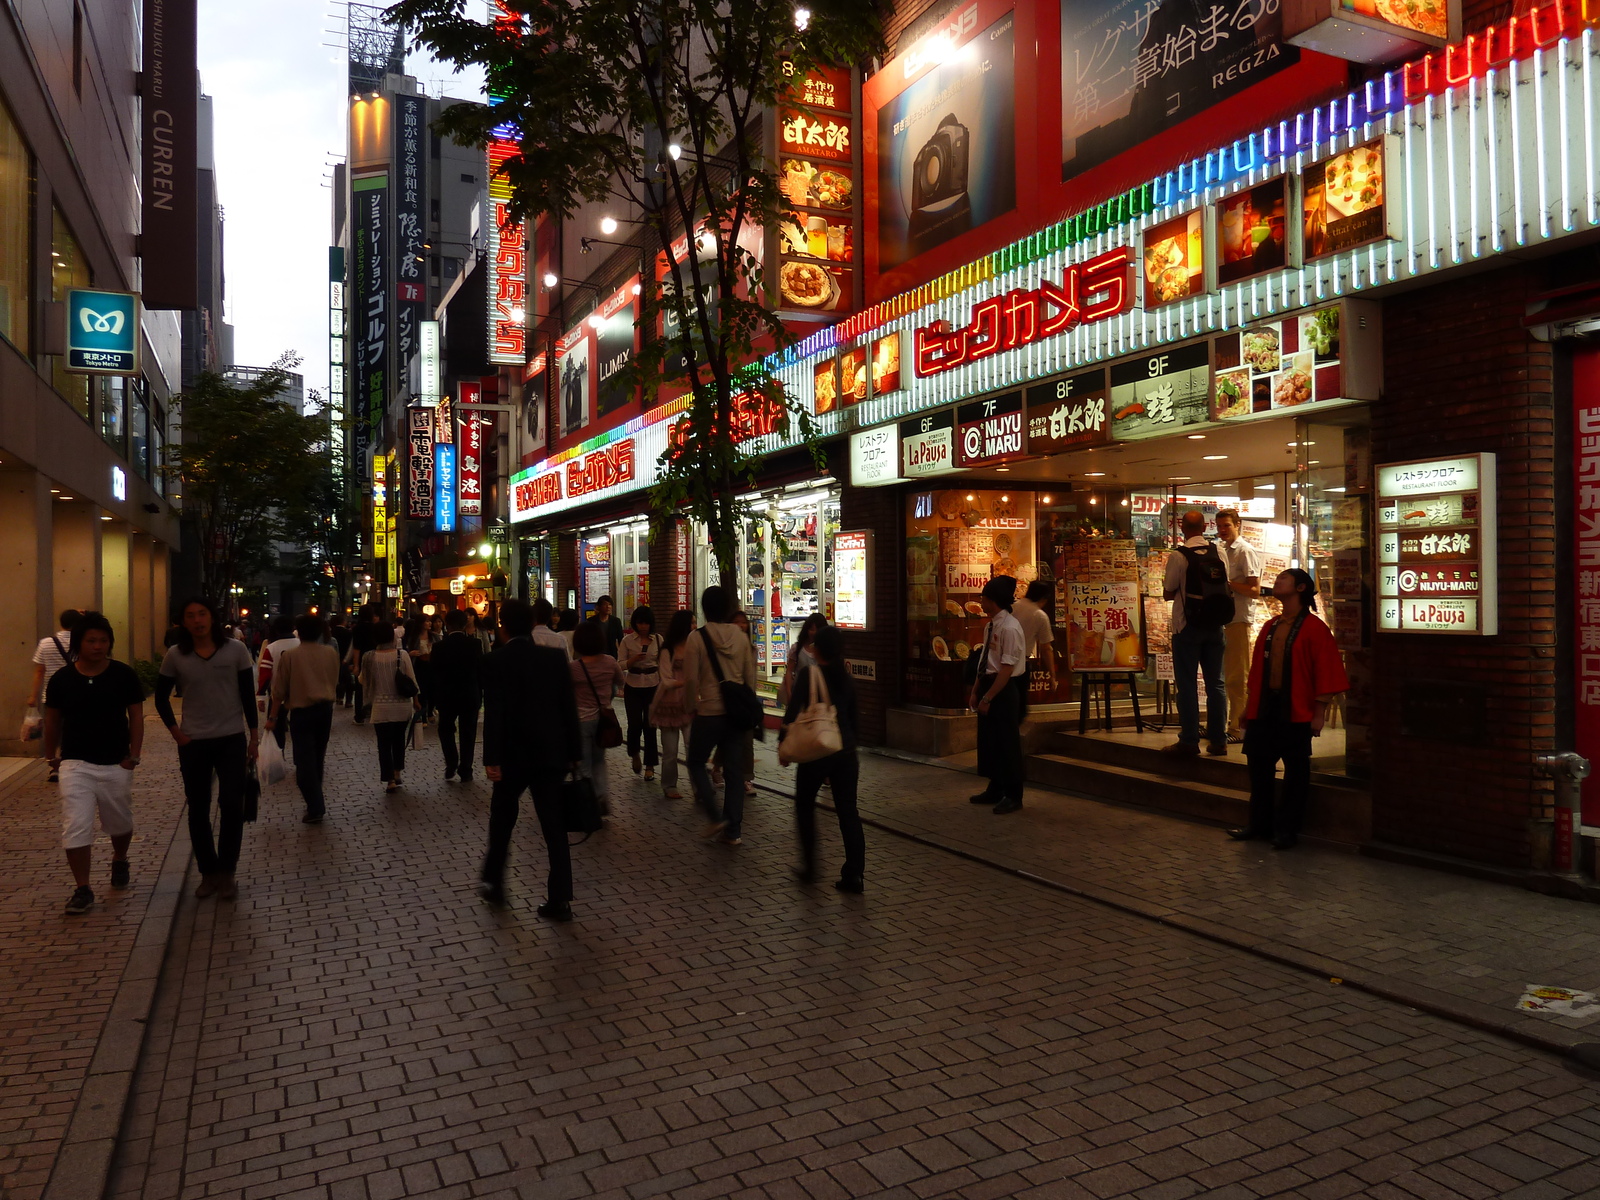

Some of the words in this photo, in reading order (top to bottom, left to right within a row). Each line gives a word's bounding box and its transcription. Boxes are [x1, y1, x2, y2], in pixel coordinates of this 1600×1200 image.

[990, 20, 1012, 40] Canon
[1212, 42, 1281, 90] REGZA
[153, 60, 163, 98] MARUI
[803, 79, 834, 93] 手作り
[803, 93, 835, 108] 居酒屋
[782, 115, 850, 152] 甘太郎
[152, 109, 173, 211] CURREN
[404, 100, 418, 209] 季節が薫る新和食。
[797, 145, 838, 159] AMATARO
[405, 284, 418, 300] 7F
[914, 244, 1137, 379] ビックカメラ
[83, 352, 122, 363] 東京メトロ
[600, 348, 630, 381] LUMIX
[1148, 355, 1169, 377] 9F
[1056, 379, 1074, 399] 8F
[982, 401, 998, 418] 7F
[920, 416, 933, 433] 6F
[985, 412, 1022, 438] NIJYU
[1048, 398, 1106, 440] 甘太郎
[859, 432, 889, 449] レストラン
[985, 431, 1022, 458] MARU
[863, 450, 886, 462] フロアー
[909, 444, 919, 466] La
[920, 440, 947, 463] Pausa
[410, 429, 434, 517] 電撃酒場
[566, 438, 636, 499] ビックカメラ
[861, 460, 888, 471] RESTAURANT
[866, 469, 881, 479] FLOOR
[1395, 467, 1464, 482] レストランフロアー
[1402, 481, 1436, 490] RESTAURANT
[1437, 479, 1457, 487] FLOOR
[1384, 511, 1395, 520] 9F
[375, 507, 386, 546] 大黒屋
[1054, 545, 1063, 554] 7F
[1384, 543, 1395, 553] 8F
[1419, 532, 1471, 556] 甘太郎
[1385, 576, 1396, 586] 7F
[1420, 581, 1479, 591] NIJYU-MARU
[1071, 585, 1109, 595] 生ビール
[1071, 595, 1118, 605] ハイボール
[1385, 609, 1396, 619] 6F
[1412, 604, 1426, 623] La
[1428, 604, 1465, 625] Pausa
